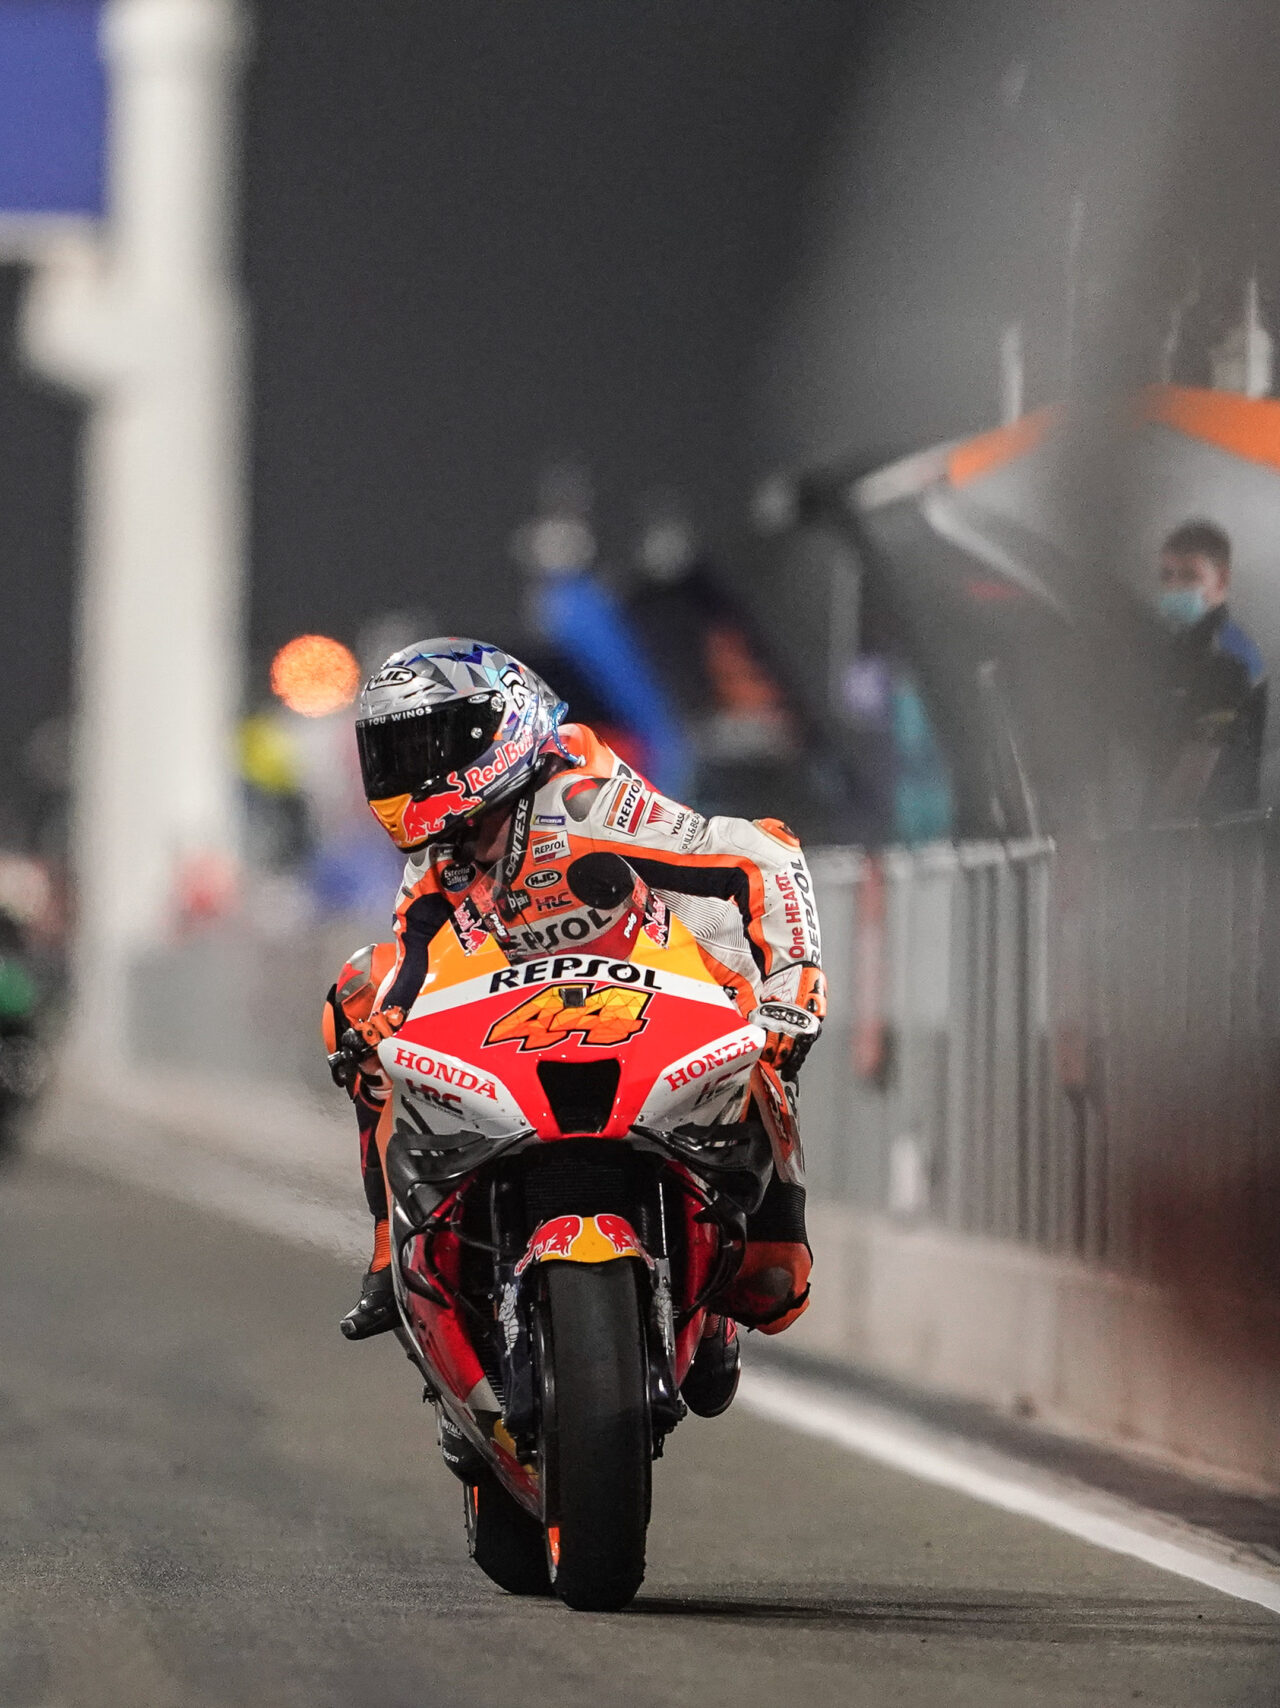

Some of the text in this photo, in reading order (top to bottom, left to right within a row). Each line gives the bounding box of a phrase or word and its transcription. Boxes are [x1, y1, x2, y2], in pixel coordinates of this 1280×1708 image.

[391, 706, 433, 721] WINGS
[465, 747, 509, 793] Red
[616, 783, 642, 829] REPSO
[505, 799, 528, 877] DAINESE
[534, 840, 566, 855] REPSOL
[530, 872, 556, 886] HJC
[535, 891, 573, 912] HRC
[503, 907, 613, 953] EPSOL
[789, 927, 805, 959] One
[489, 957, 663, 994] REPSOL
[481, 982, 656, 1053] 44
[394, 1047, 498, 1102] HONDA
[664, 1036, 759, 1092] HONDA
[405, 1077, 464, 1116] HRC
